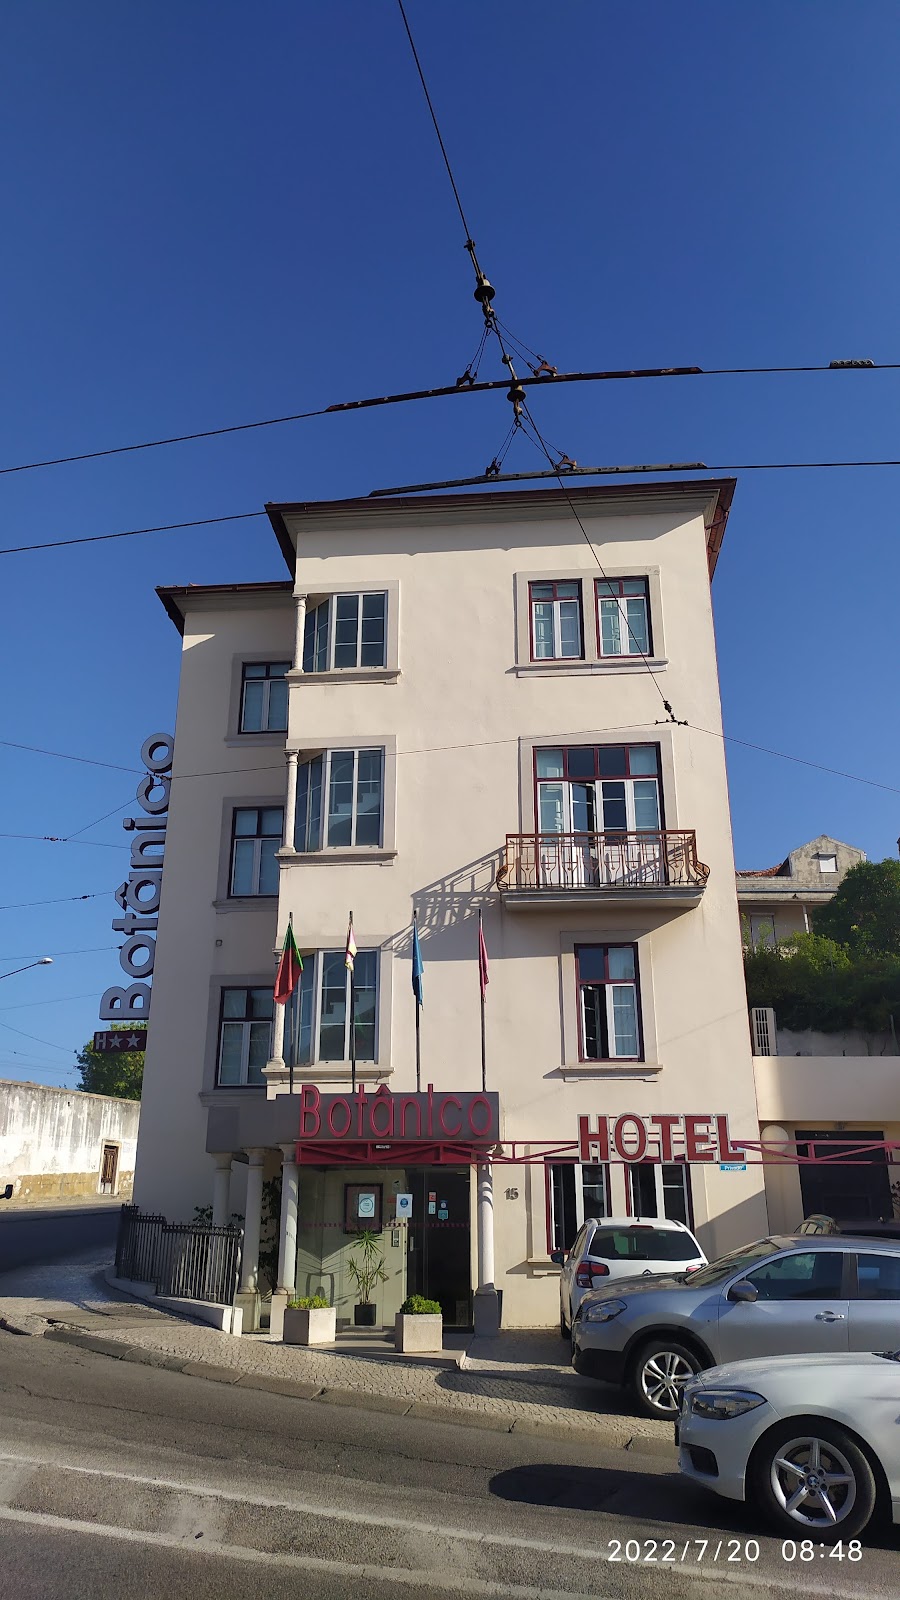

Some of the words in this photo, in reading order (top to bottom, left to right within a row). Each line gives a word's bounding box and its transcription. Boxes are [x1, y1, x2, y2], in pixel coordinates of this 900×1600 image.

[99, 732, 175, 1021] Botânico
[299, 1083, 492, 1138] Botânico
[577, 1112, 747, 1164] HOTEL
[504, 1187, 519, 1200] 15
